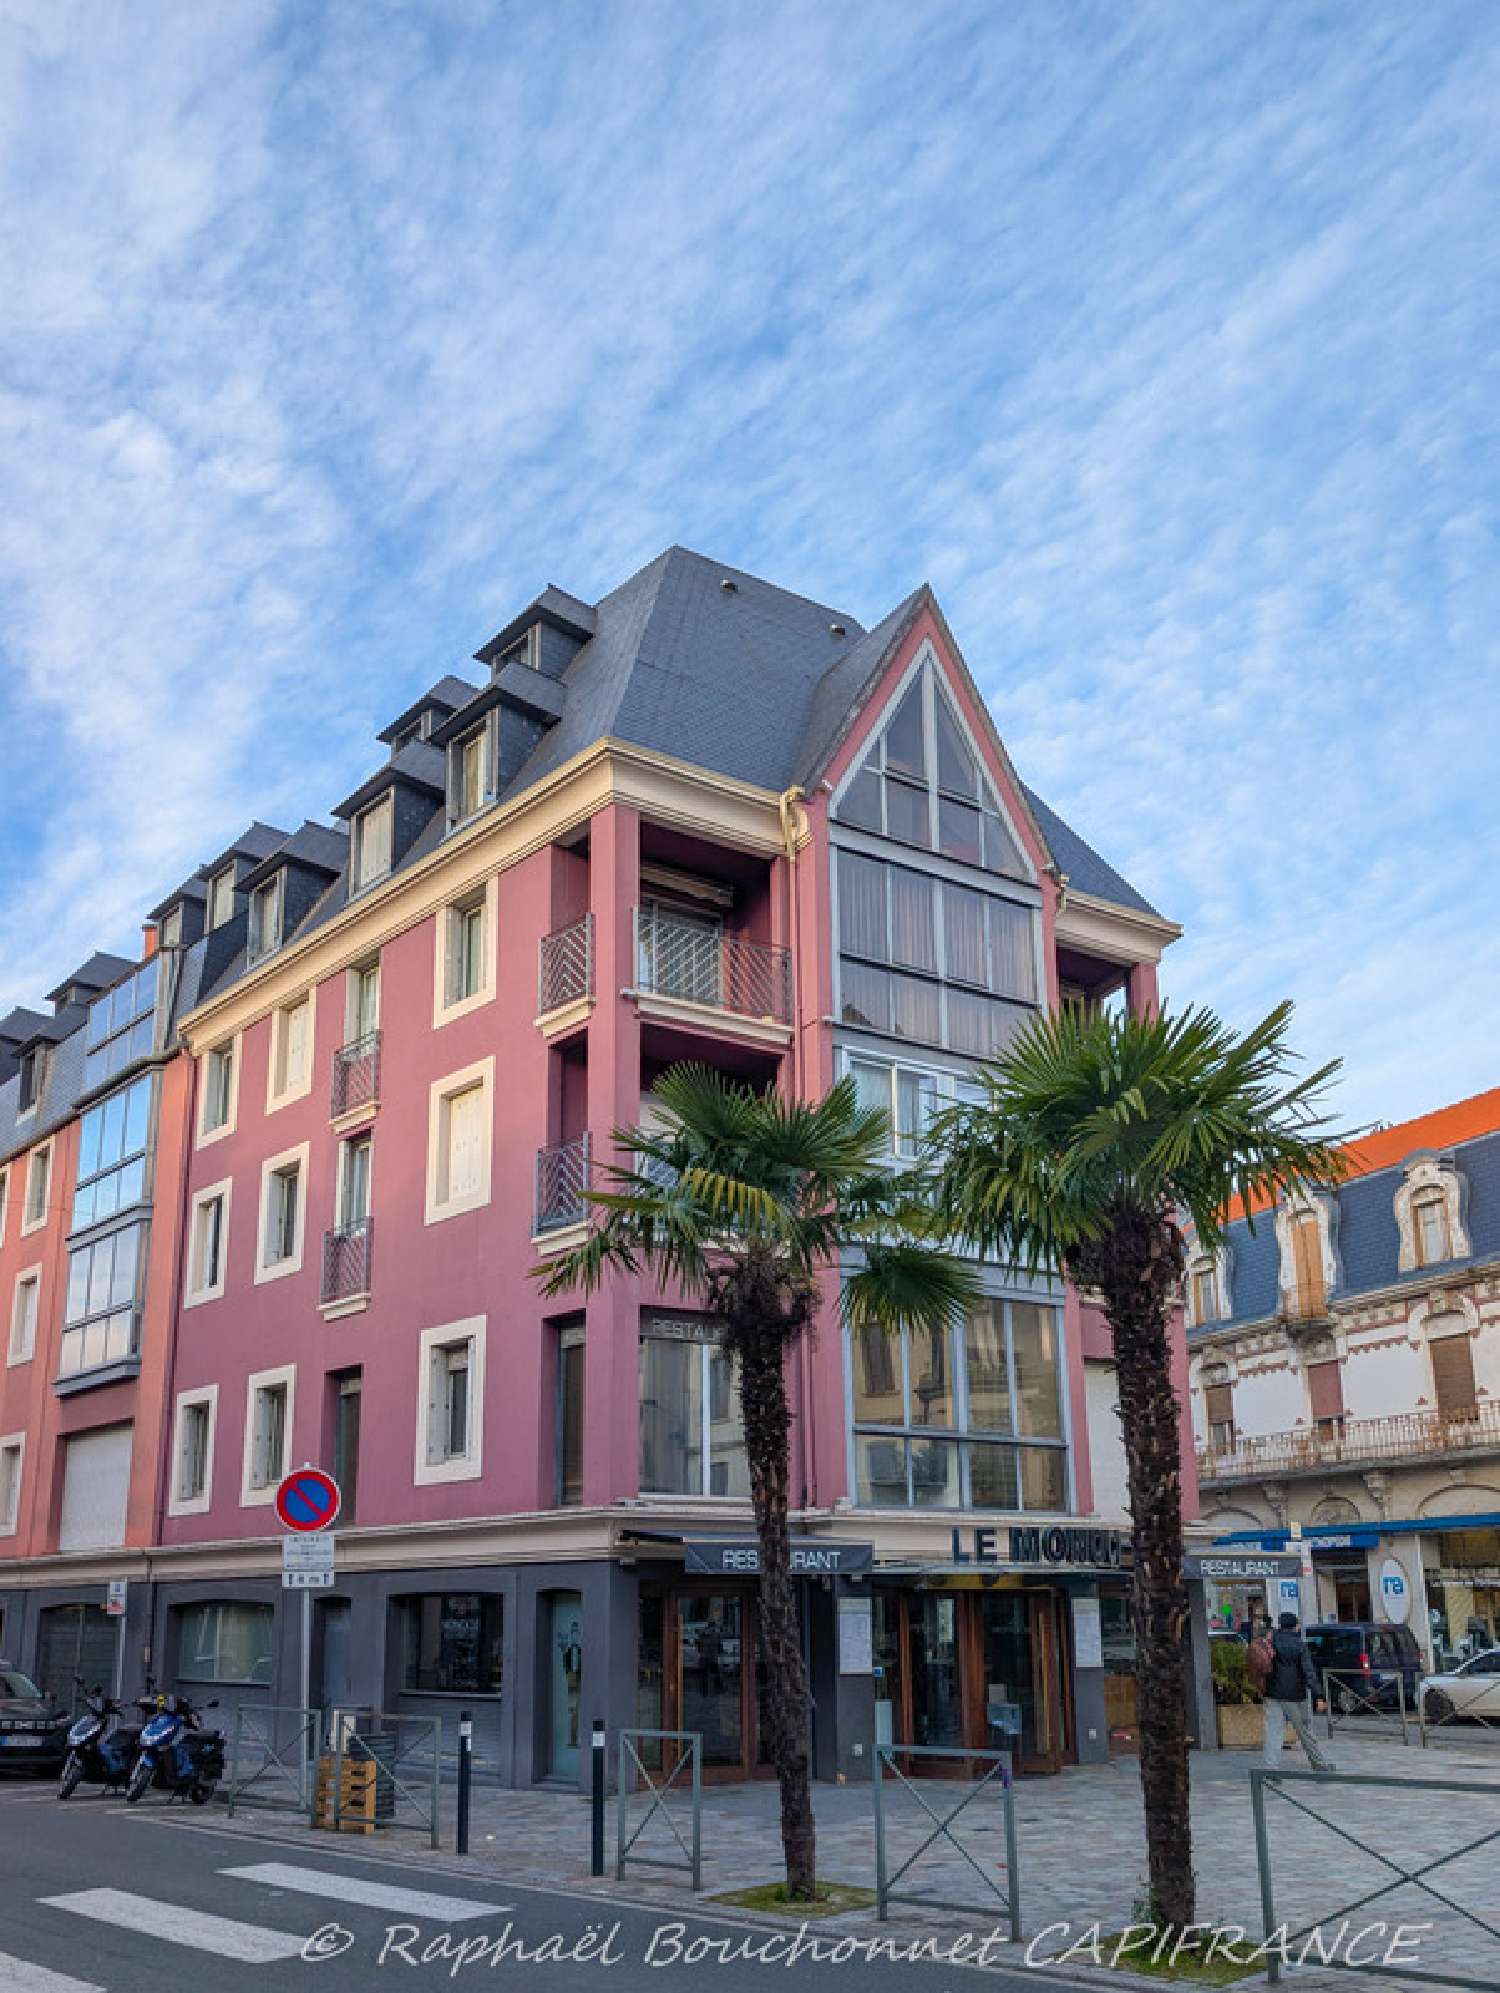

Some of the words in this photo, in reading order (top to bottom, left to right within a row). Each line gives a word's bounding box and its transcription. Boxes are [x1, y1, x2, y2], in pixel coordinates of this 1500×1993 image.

[952, 1527, 998, 1563] LE
[722, 1549, 841, 1570] RESRANT
[1200, 1558, 1280, 1575] RESTAURANT
